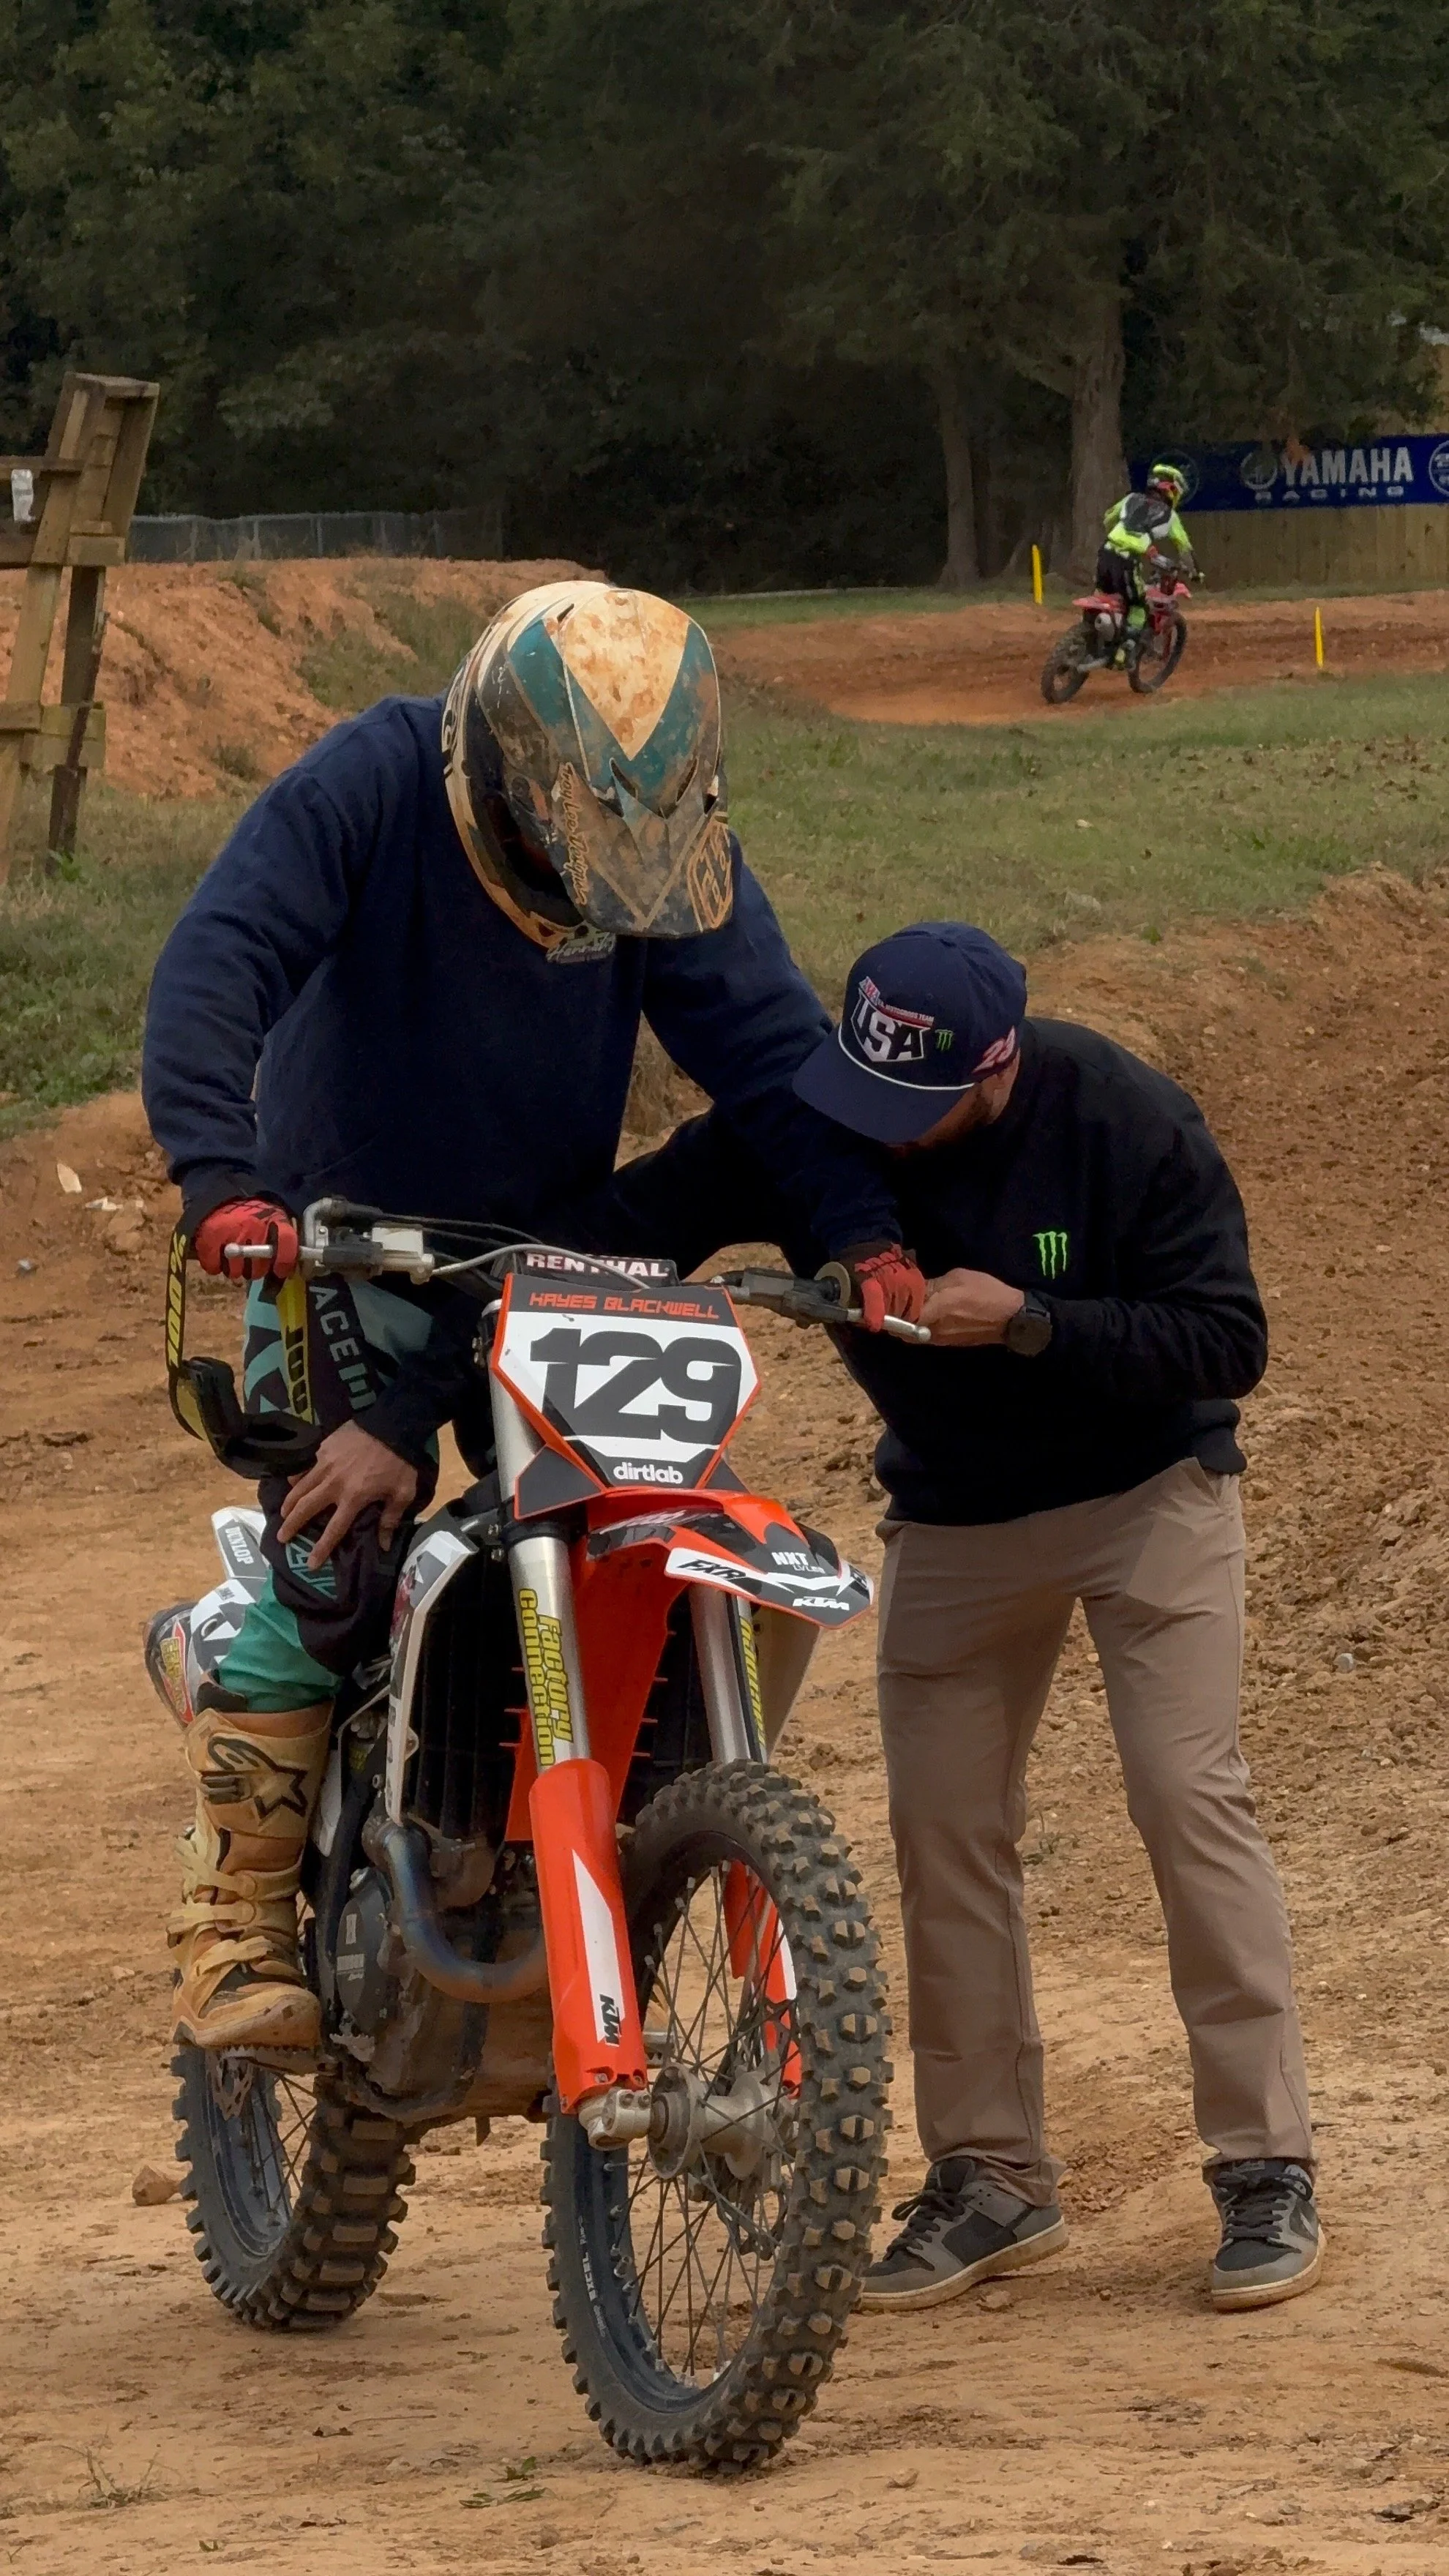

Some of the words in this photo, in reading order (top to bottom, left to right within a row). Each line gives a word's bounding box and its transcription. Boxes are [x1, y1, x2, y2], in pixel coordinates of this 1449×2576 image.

[1282, 447, 1413, 486] YAMAHA
[1254, 486, 1404, 501] RACING
[851, 988, 924, 1063] USA
[168, 1232, 187, 1368] 100%
[529, 1292, 598, 1310] HAYES
[603, 1296, 720, 1319] BLACKWELL
[530, 1327, 742, 1445] 129
[613, 1461, 684, 1484] dirtlab
[225, 1526, 255, 1565] DUNLOP
[771, 1551, 809, 1565] NXT
[678, 1558, 746, 1580] FXR
[793, 1595, 850, 1611] KTM
[599, 1993, 622, 2047] KTM
